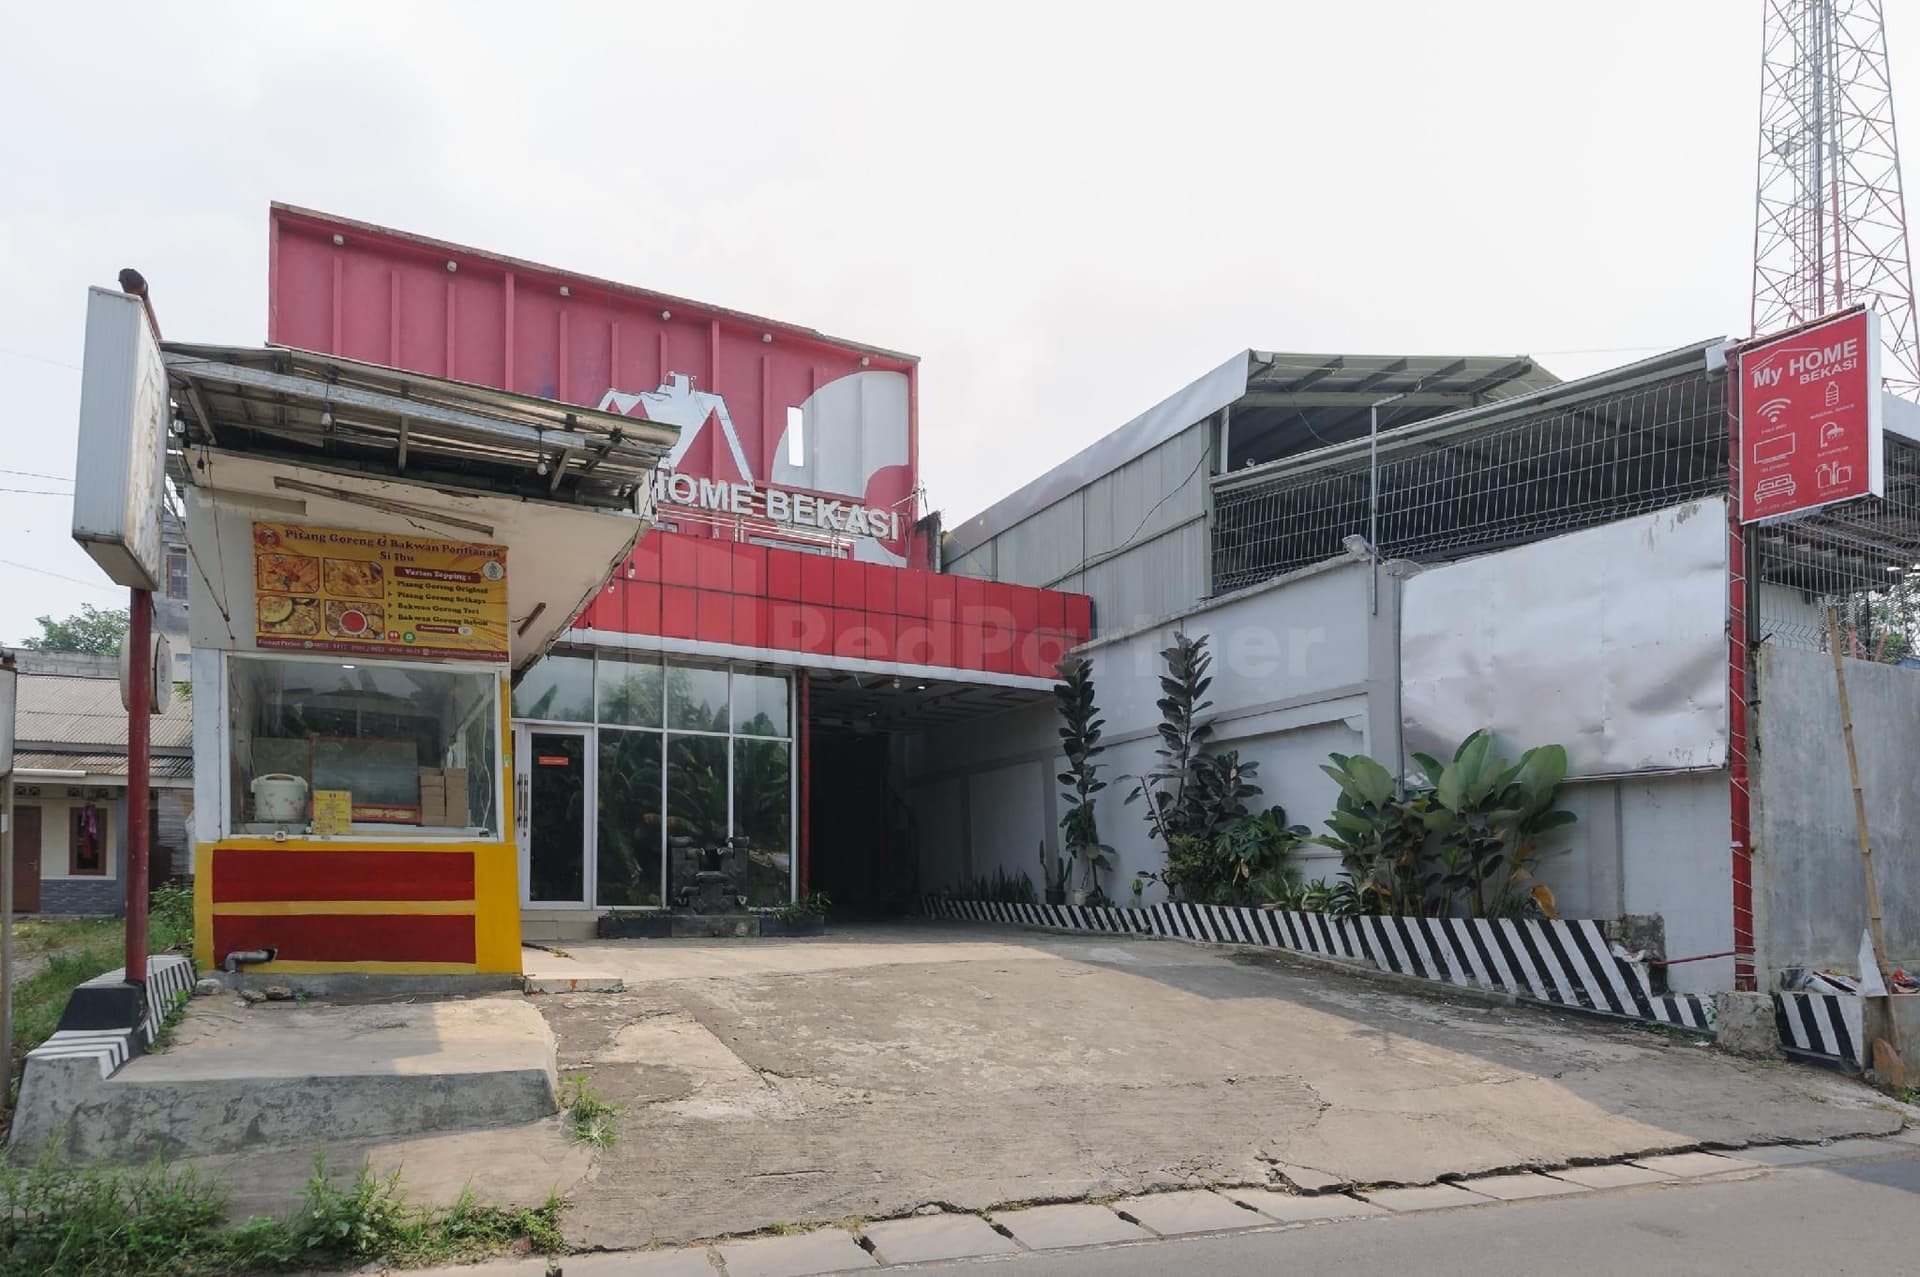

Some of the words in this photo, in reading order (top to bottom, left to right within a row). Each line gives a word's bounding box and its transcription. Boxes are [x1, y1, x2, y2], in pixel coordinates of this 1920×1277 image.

[1753, 367, 1783, 389] My
[1789, 338, 1858, 377] HOME
[1799, 358, 1857, 385] BEKASI
[766, 489, 898, 541] BEKASI
[285, 528, 326, 543] Pisang
[329, 533, 374, 547] Goreng
[390, 539, 439, 553] Bakwan
[442, 544, 500, 558] Pontianak
[379, 551, 391, 560] Si
